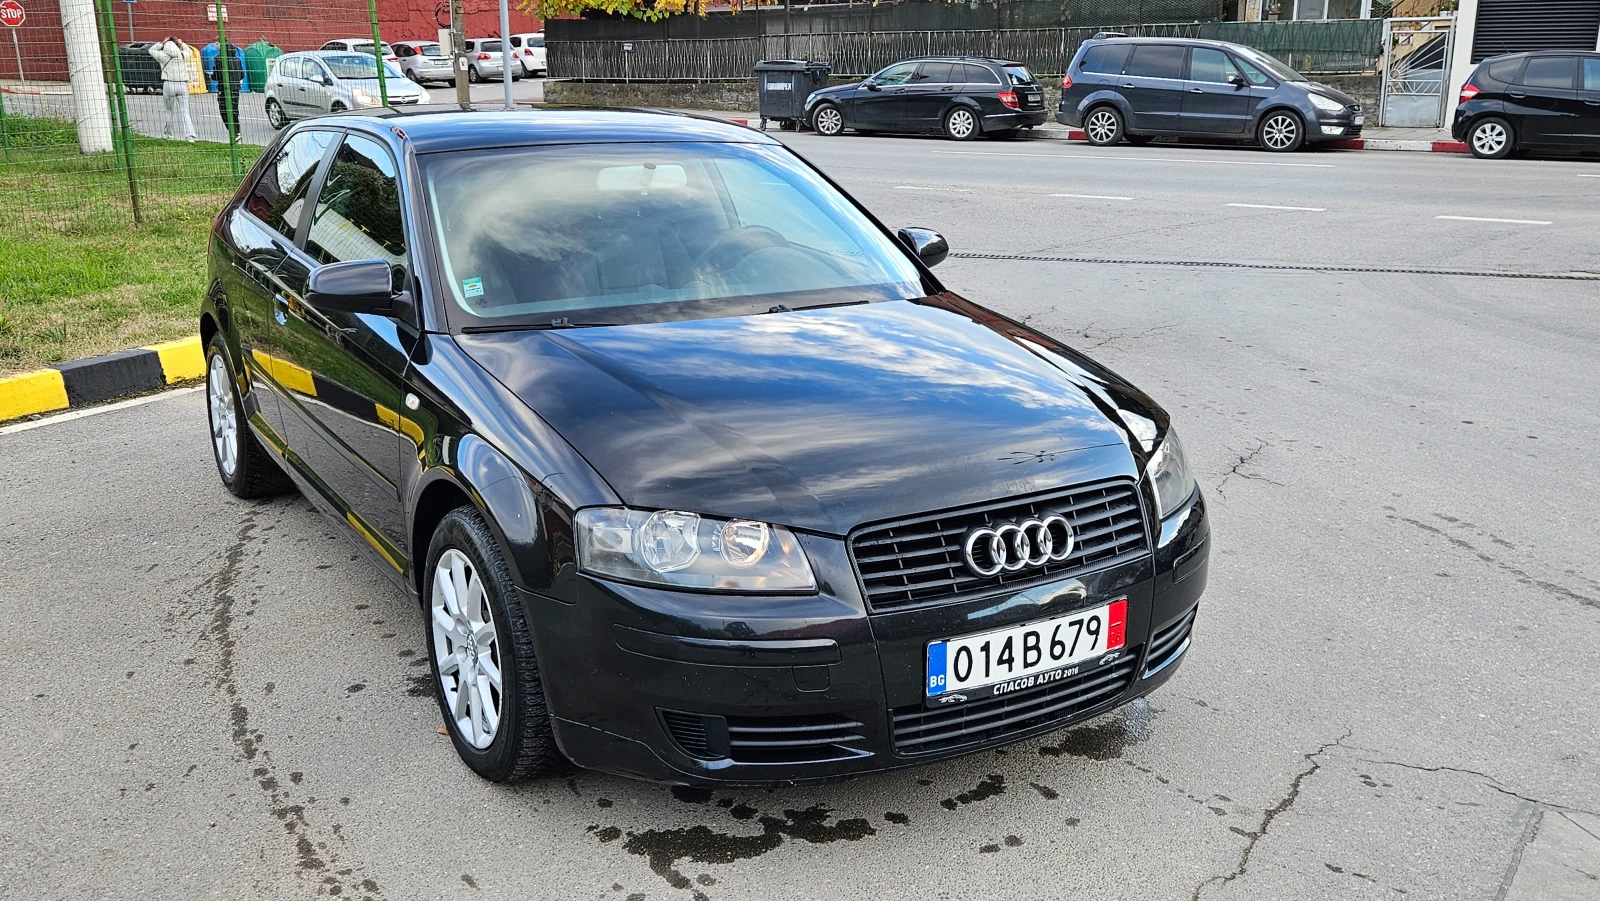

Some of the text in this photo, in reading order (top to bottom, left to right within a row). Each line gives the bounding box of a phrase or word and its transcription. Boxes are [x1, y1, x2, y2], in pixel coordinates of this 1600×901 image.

[1, 8, 22, 19] STOP
[930, 674, 945, 688] BG
[993, 666, 1079, 695] СПАСОВ АУТО 2016
